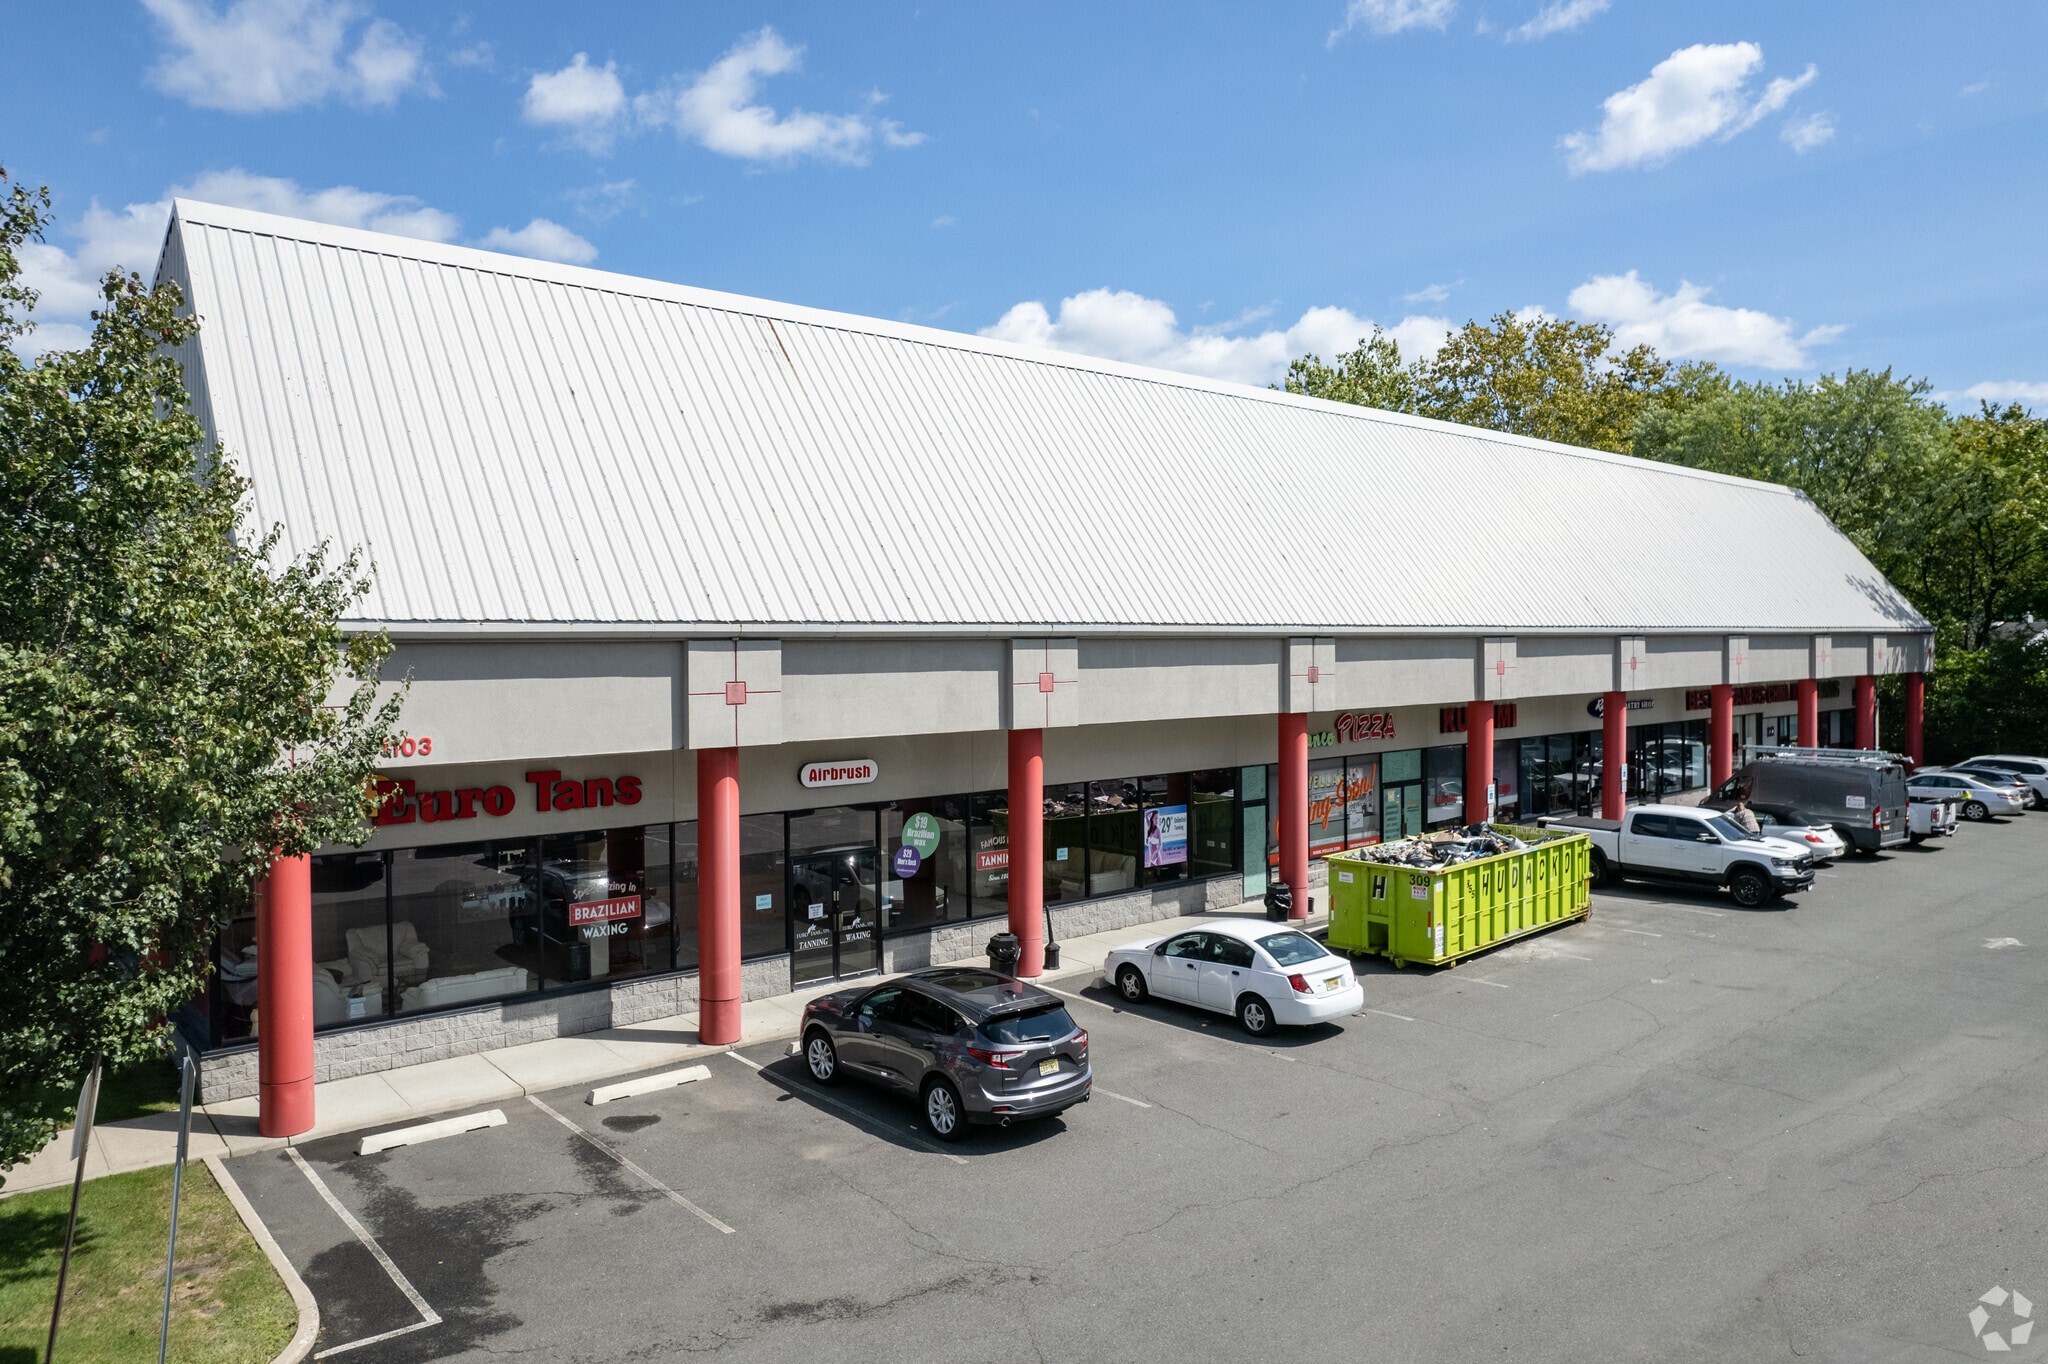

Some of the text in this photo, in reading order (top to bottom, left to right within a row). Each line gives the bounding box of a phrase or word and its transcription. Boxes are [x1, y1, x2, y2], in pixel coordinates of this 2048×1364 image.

[1626, 702, 1640, 710] STRY
[1440, 704, 1517, 733] KUMI
[1335, 713, 1397, 744] PIZZA
[809, 765, 871, 782] Airbrush
[373, 770, 643, 826] Euro Tans
[915, 815, 928, 828] $19
[907, 828, 935, 840] Brazilian
[980, 835, 1006, 850] FAMOUS
[981, 853, 1009, 867] TANNIN
[628, 881, 637, 892] in
[1373, 875, 1388, 900] H
[1409, 874, 1431, 887] 309
[574, 901, 635, 921] BRAZILIAN
[583, 922, 628, 939] WAXING
[845, 930, 871, 942] WAXING
[799, 937, 829, 950] TANNING
